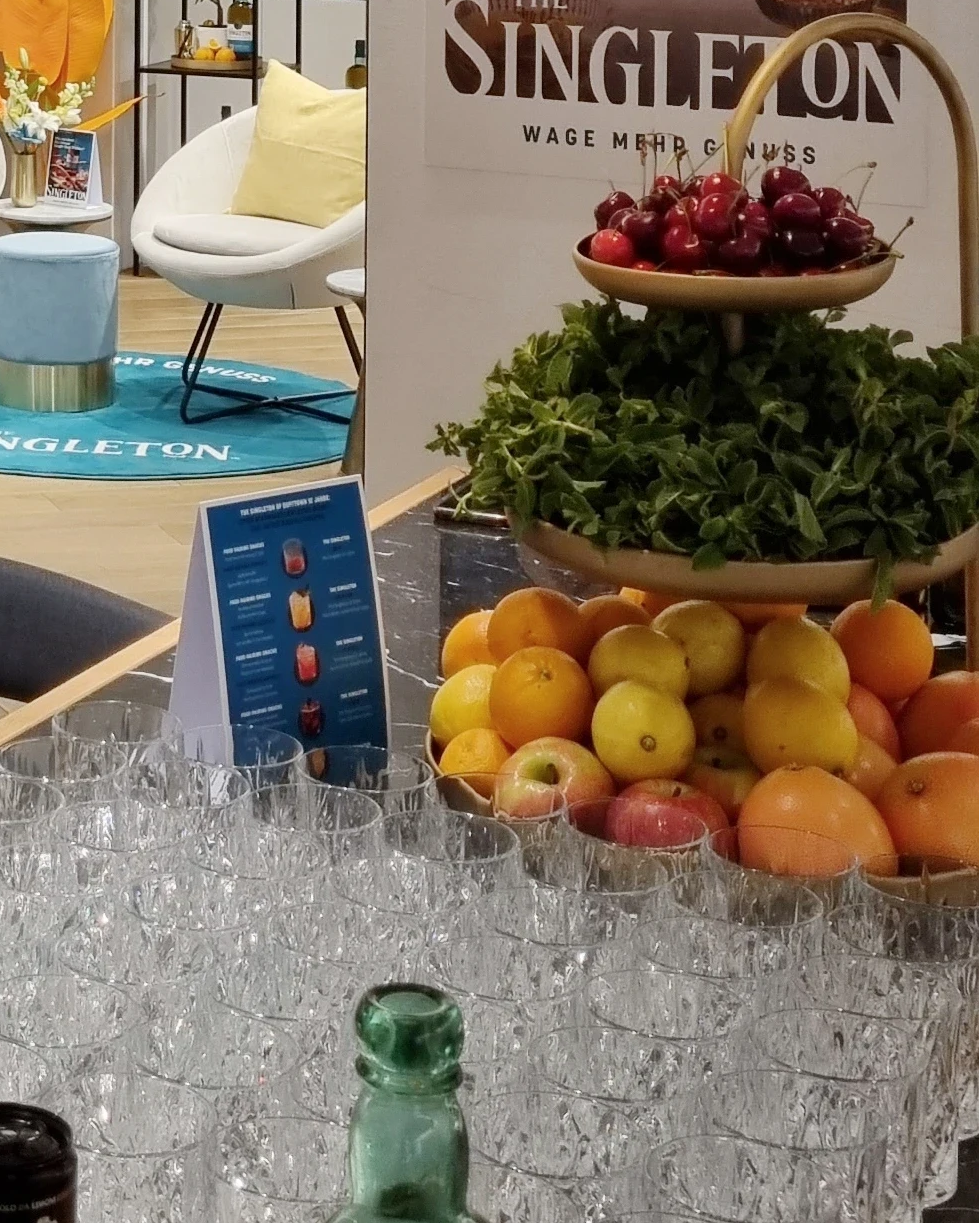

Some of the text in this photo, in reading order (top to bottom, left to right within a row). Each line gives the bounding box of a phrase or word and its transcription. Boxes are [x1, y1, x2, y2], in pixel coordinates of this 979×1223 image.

[523, 124, 595, 148] WAGE
[704, 138, 816, 165] GNUSS
[46, 185, 87, 201] SINGLETON
